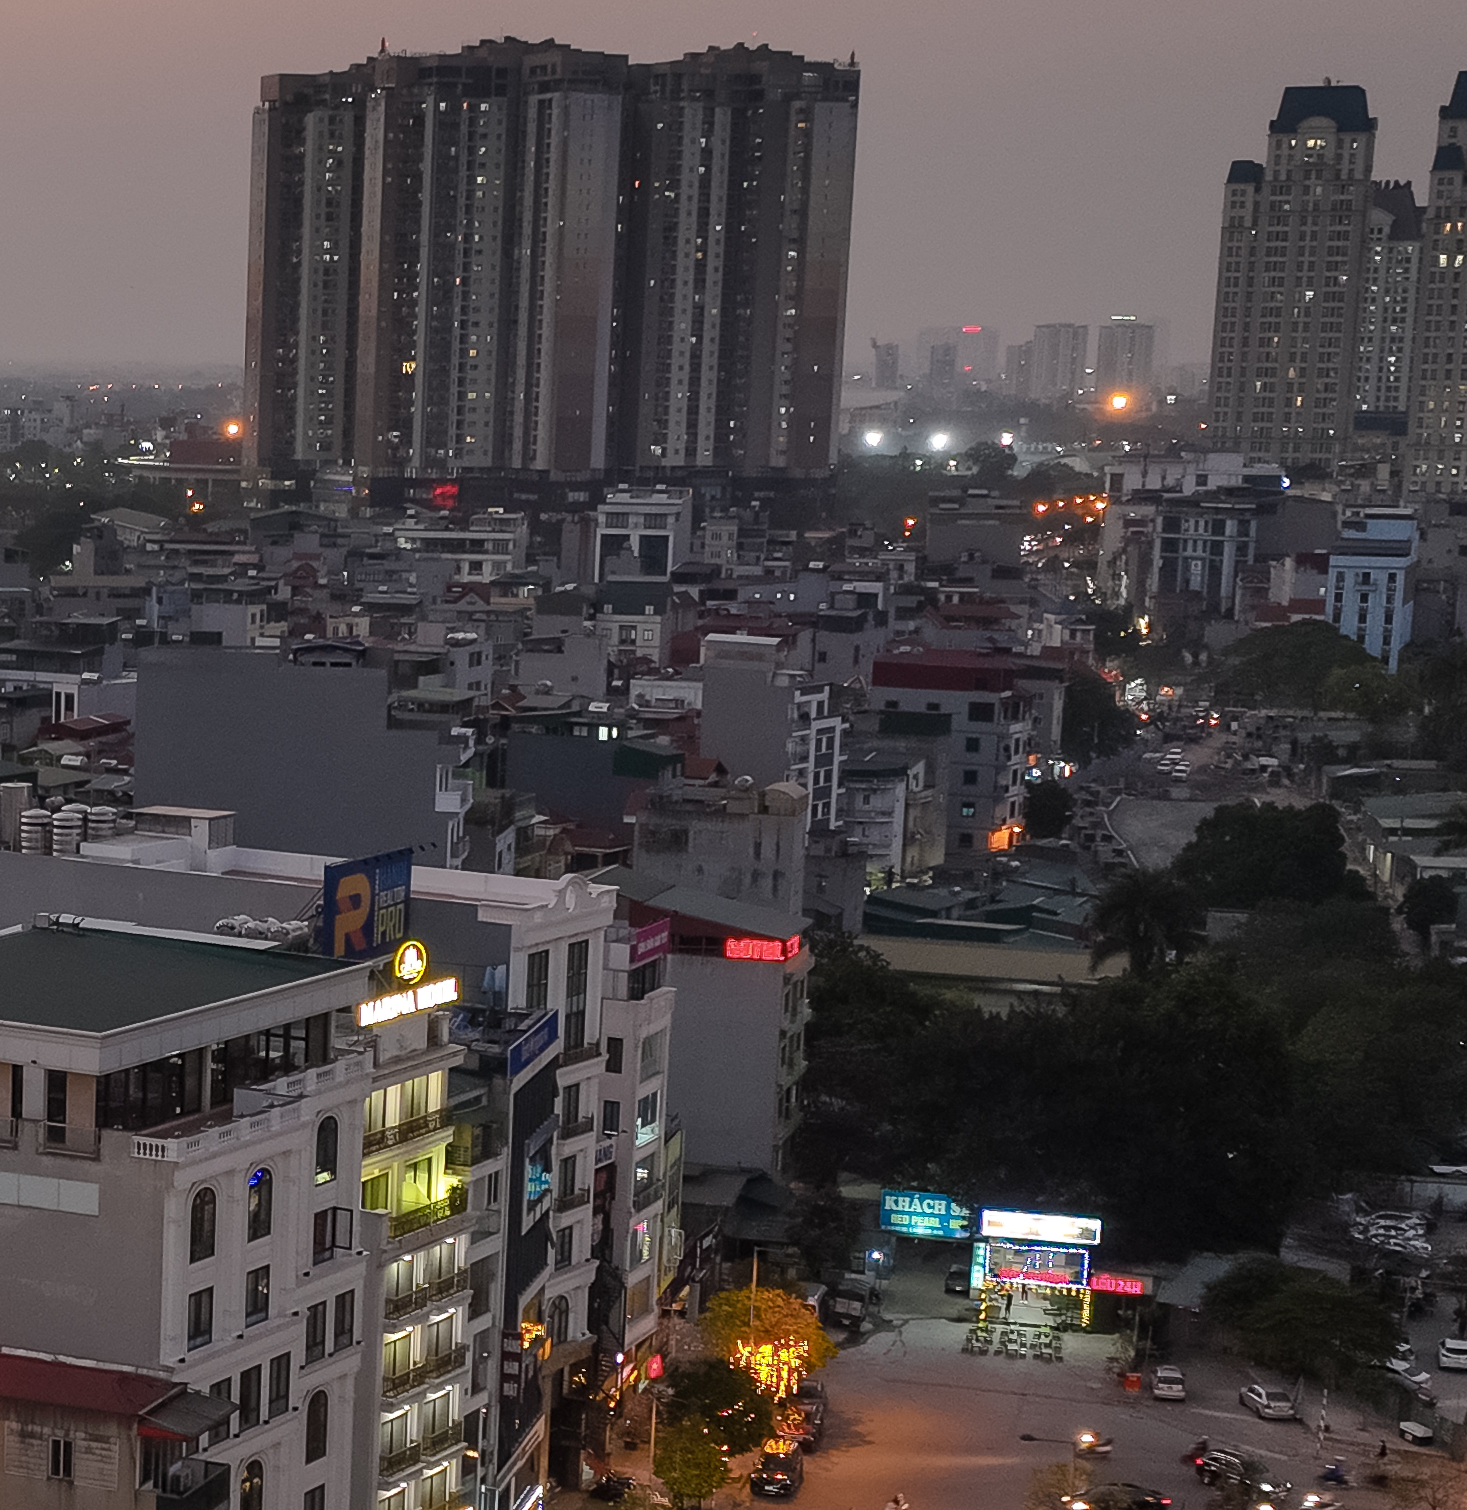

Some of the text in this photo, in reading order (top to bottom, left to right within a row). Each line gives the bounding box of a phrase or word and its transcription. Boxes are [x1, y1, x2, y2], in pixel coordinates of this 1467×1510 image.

[377, 903, 404, 945] PRO
[883, 1193, 947, 1214] KHÁCH
[890, 1212, 910, 1224] RED
[910, 1214, 941, 1227] PEARL
